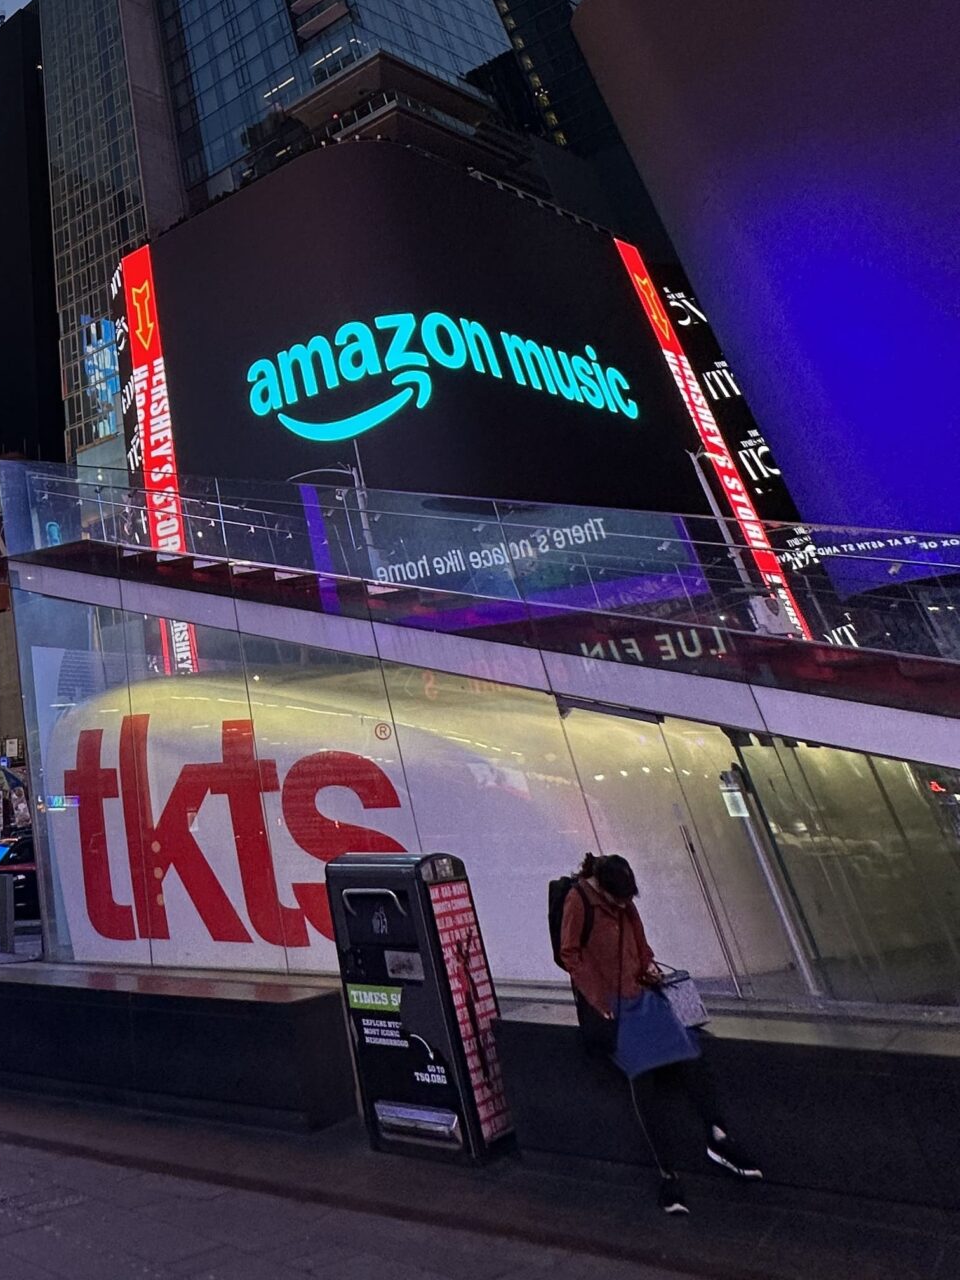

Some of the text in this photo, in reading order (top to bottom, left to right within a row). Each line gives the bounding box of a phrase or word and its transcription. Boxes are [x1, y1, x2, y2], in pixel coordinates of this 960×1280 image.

[247, 312, 502, 417] amazon
[500, 331, 638, 419] music
[64, 713, 408, 948] tkts
[350, 990, 389, 1006] TIMES
[365, 1036, 409, 1049] NEIGHBORHOOD
